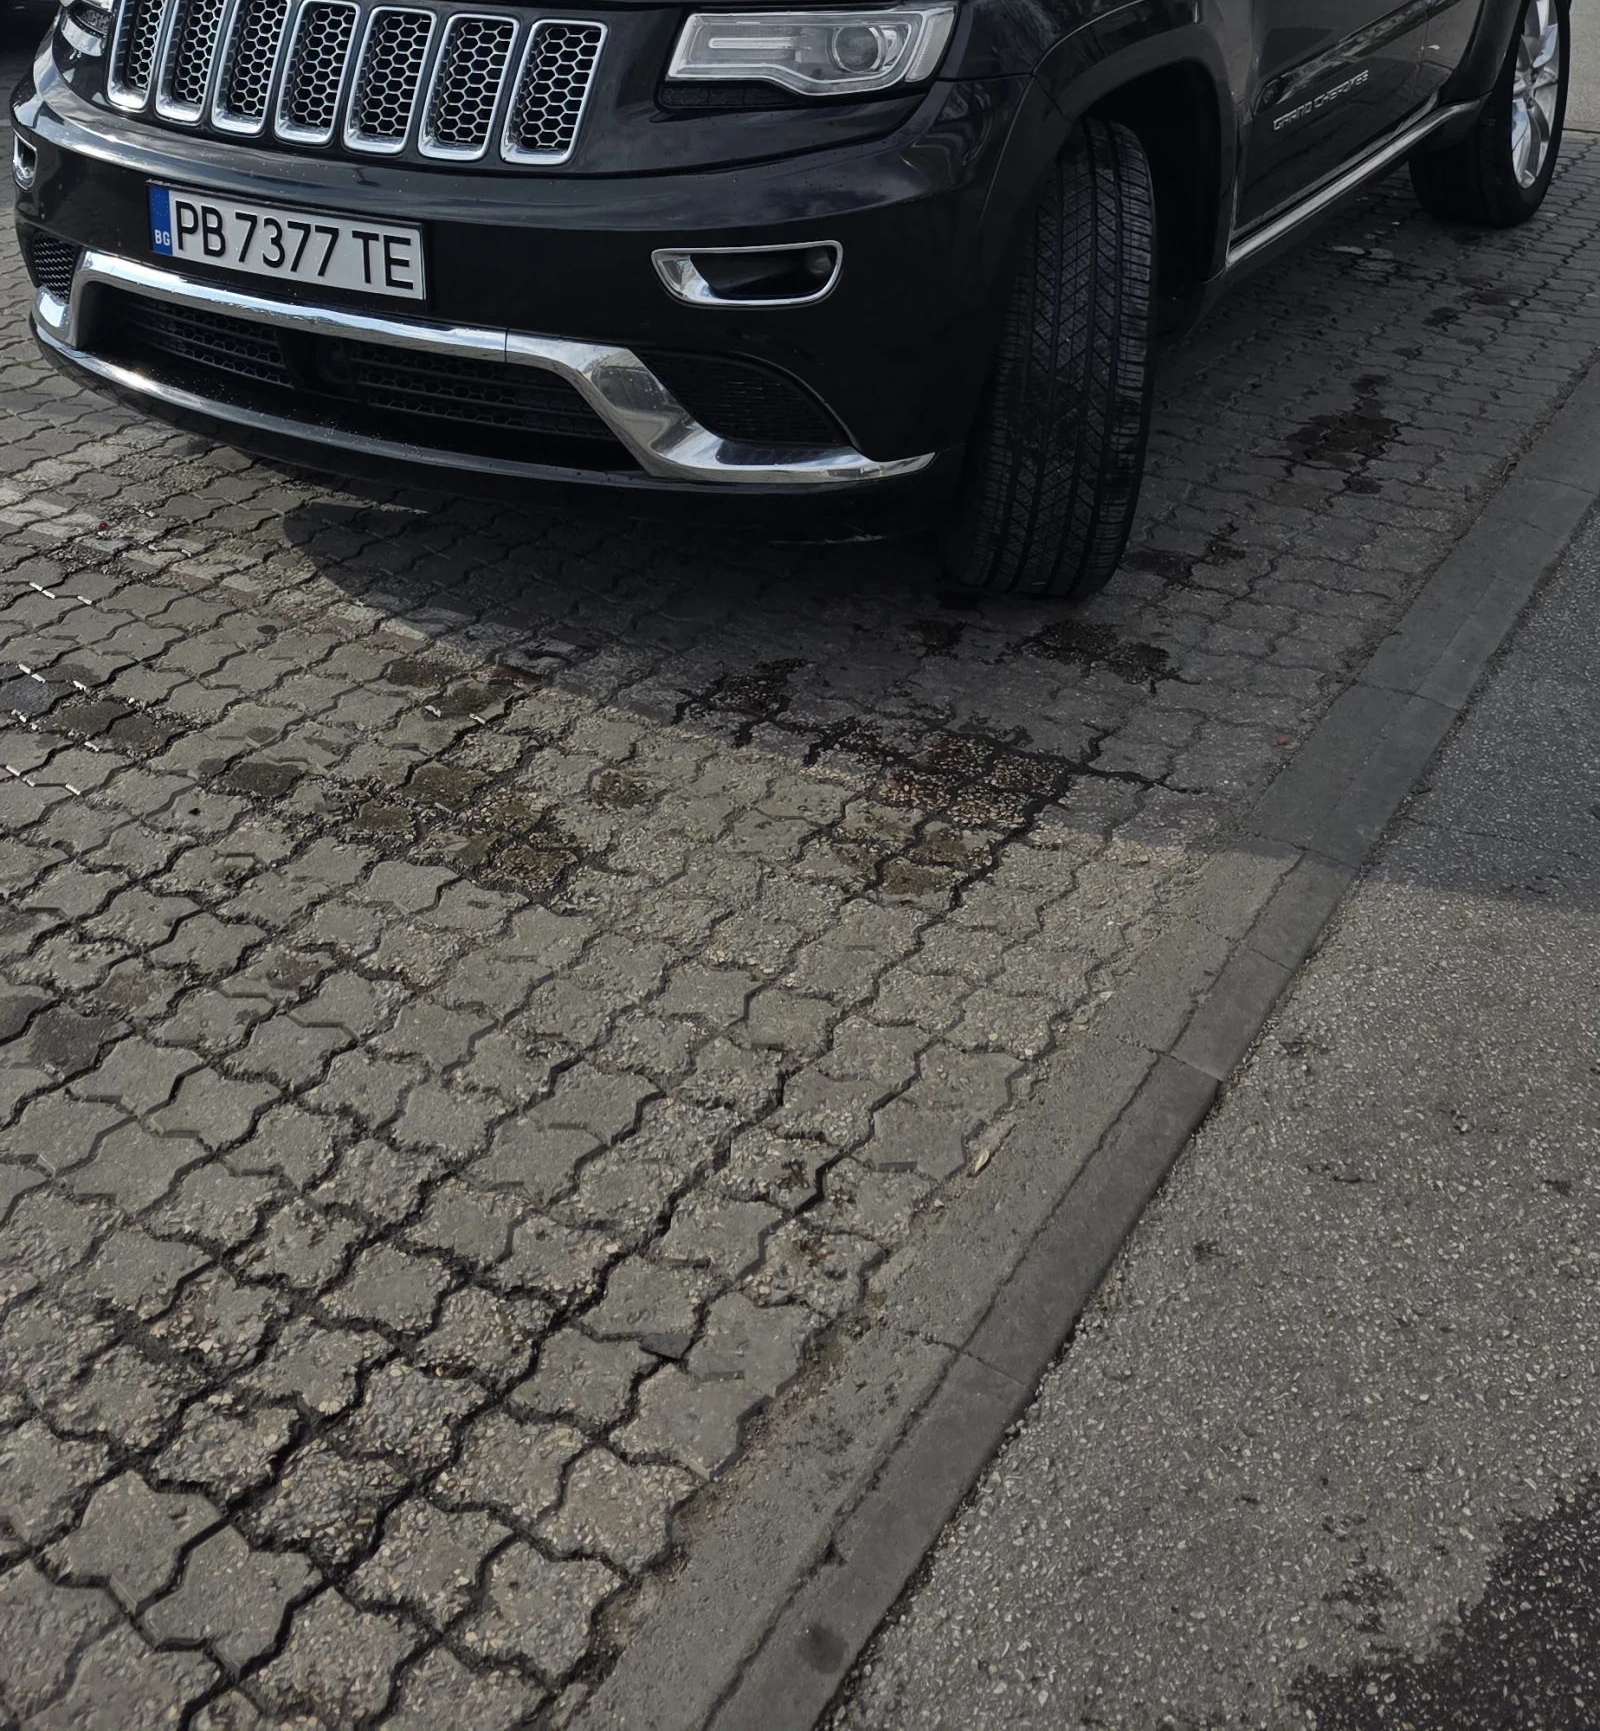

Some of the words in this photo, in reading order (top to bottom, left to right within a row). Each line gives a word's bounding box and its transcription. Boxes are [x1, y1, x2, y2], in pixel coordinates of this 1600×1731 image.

[1273, 101, 1312, 131] GRAND
[1313, 69, 1369, 109] CHEROKEE
[154, 229, 171, 246] BG
[175, 200, 226, 258] PB
[235, 211, 340, 277] 7377
[351, 230, 414, 290] TE
